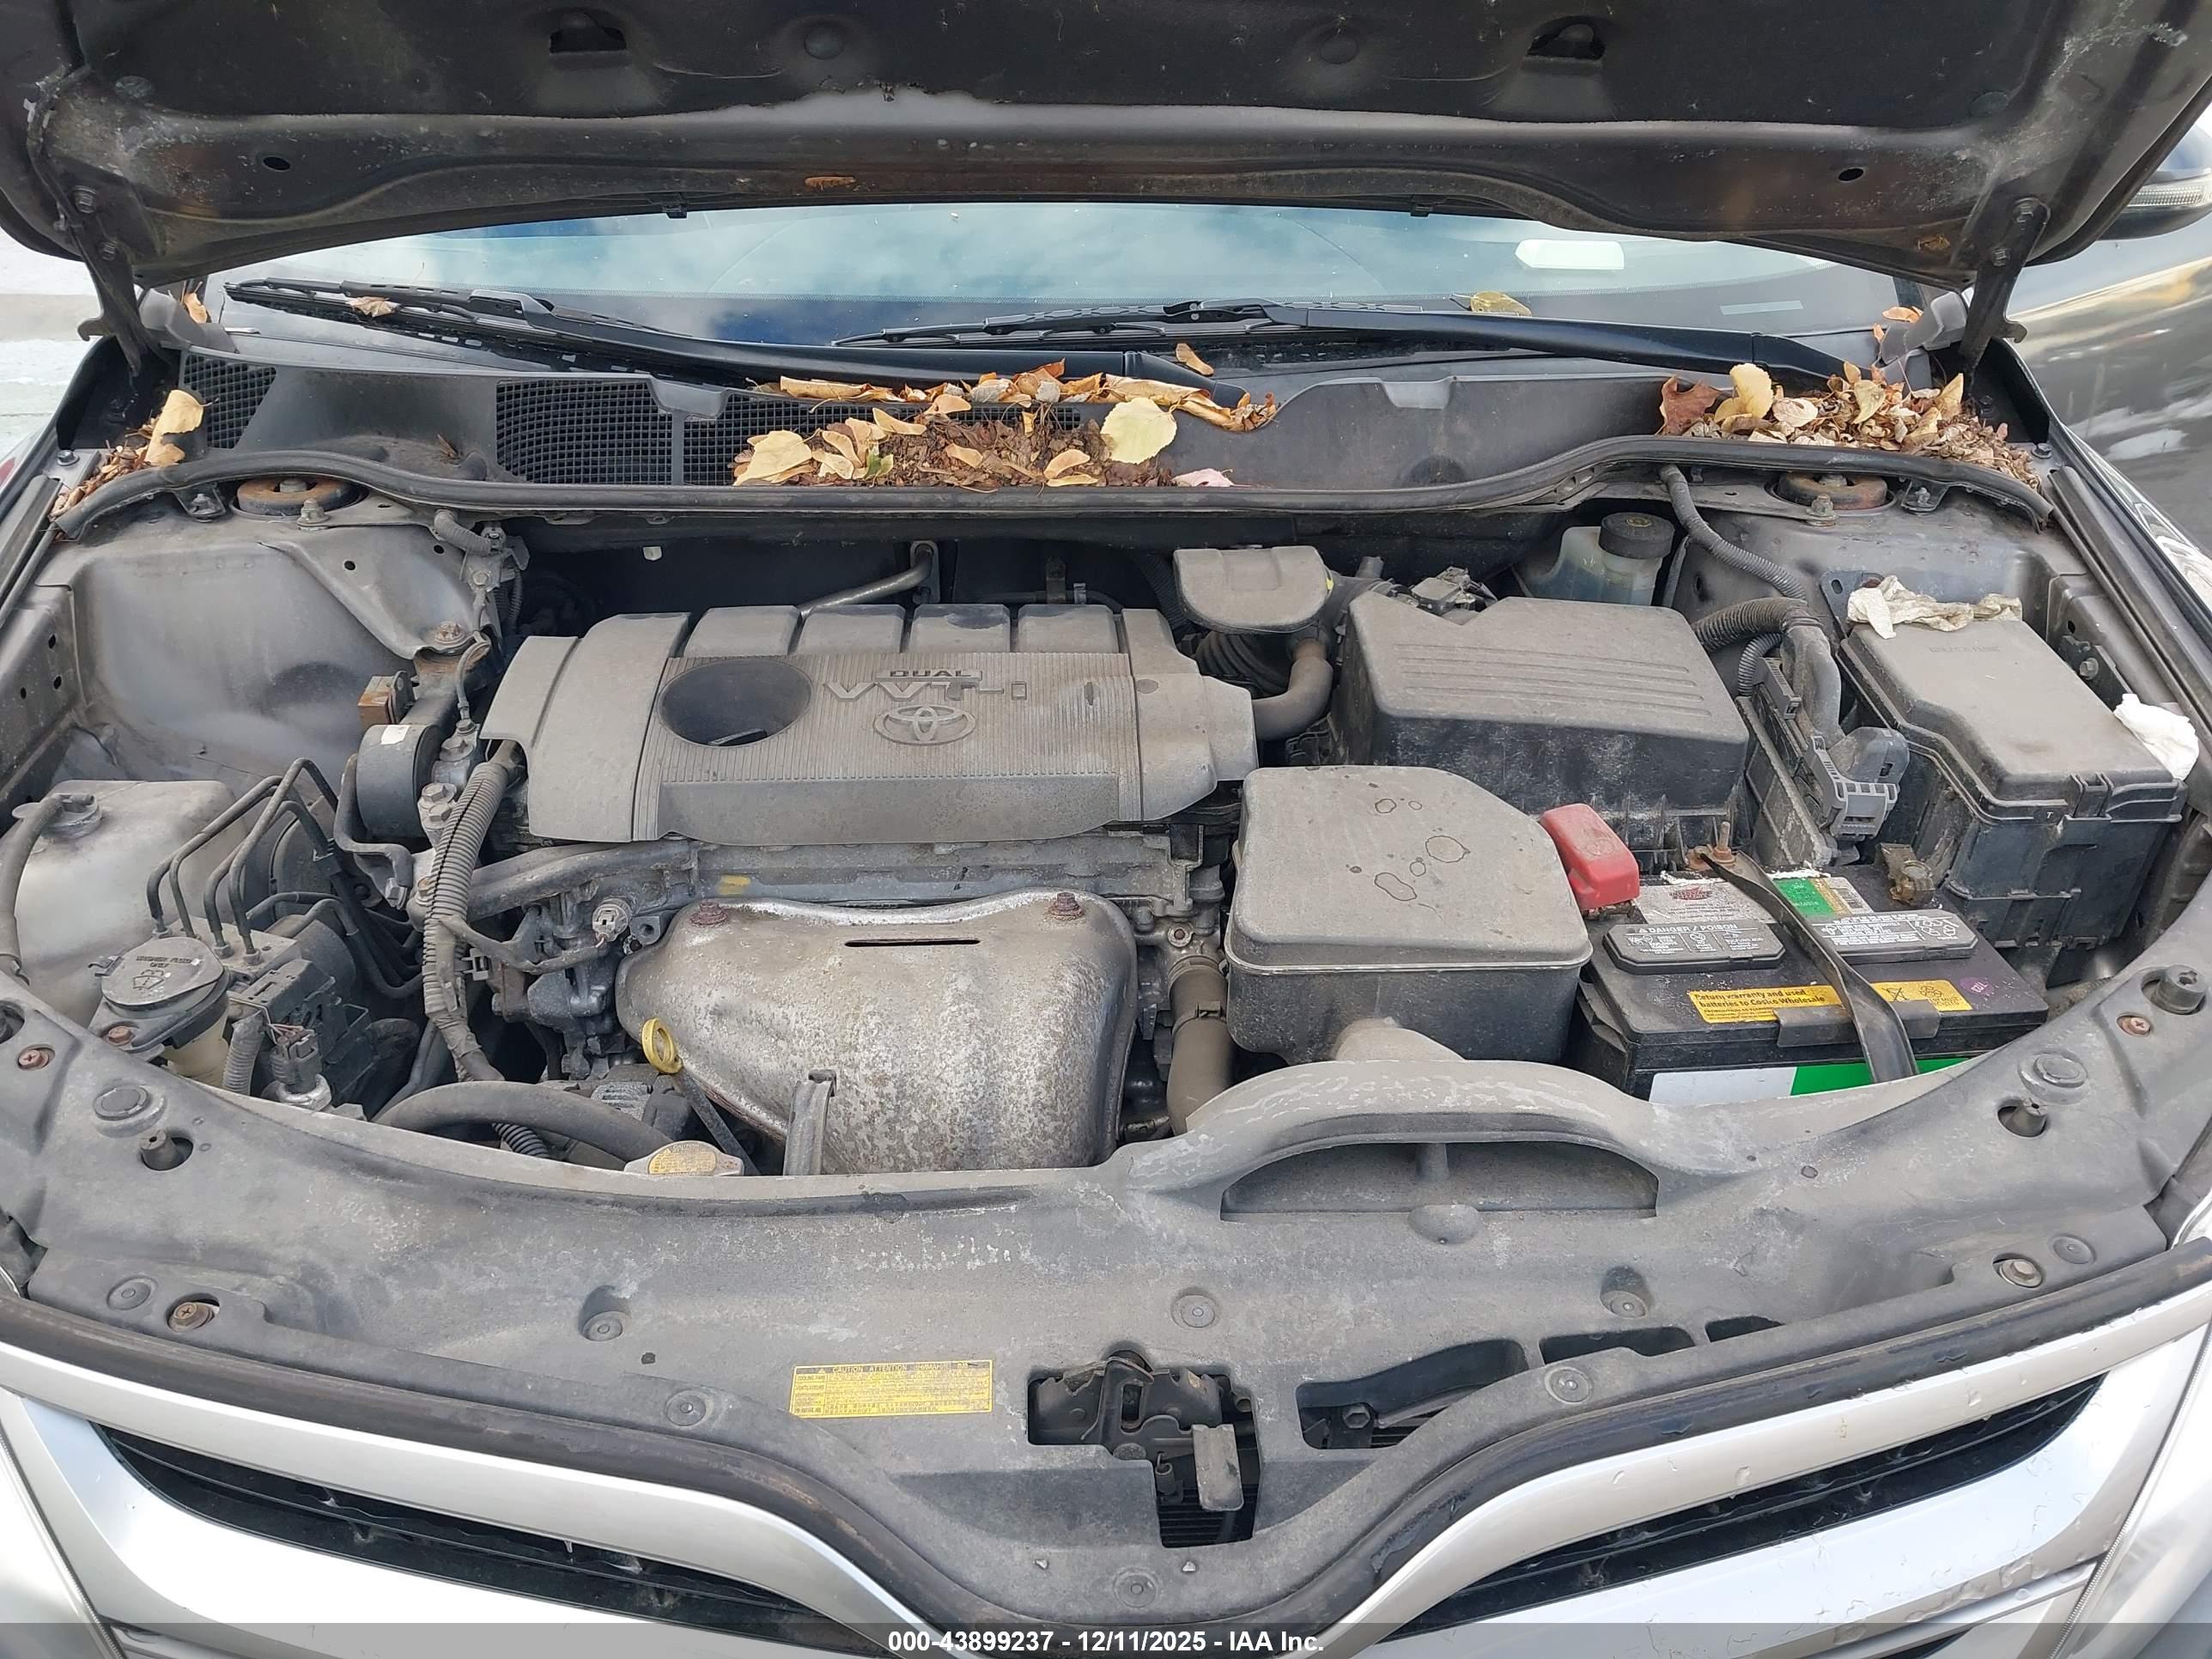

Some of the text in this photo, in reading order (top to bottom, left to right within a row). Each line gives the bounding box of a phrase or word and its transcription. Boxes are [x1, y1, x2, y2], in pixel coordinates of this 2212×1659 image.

[1699, 923, 1739, 932] POISON
[1726, 992, 1765, 1000] warranty
[1779, 996, 1826, 1005] Wholesale
[869, 1364, 907, 1372] ATTENTION
